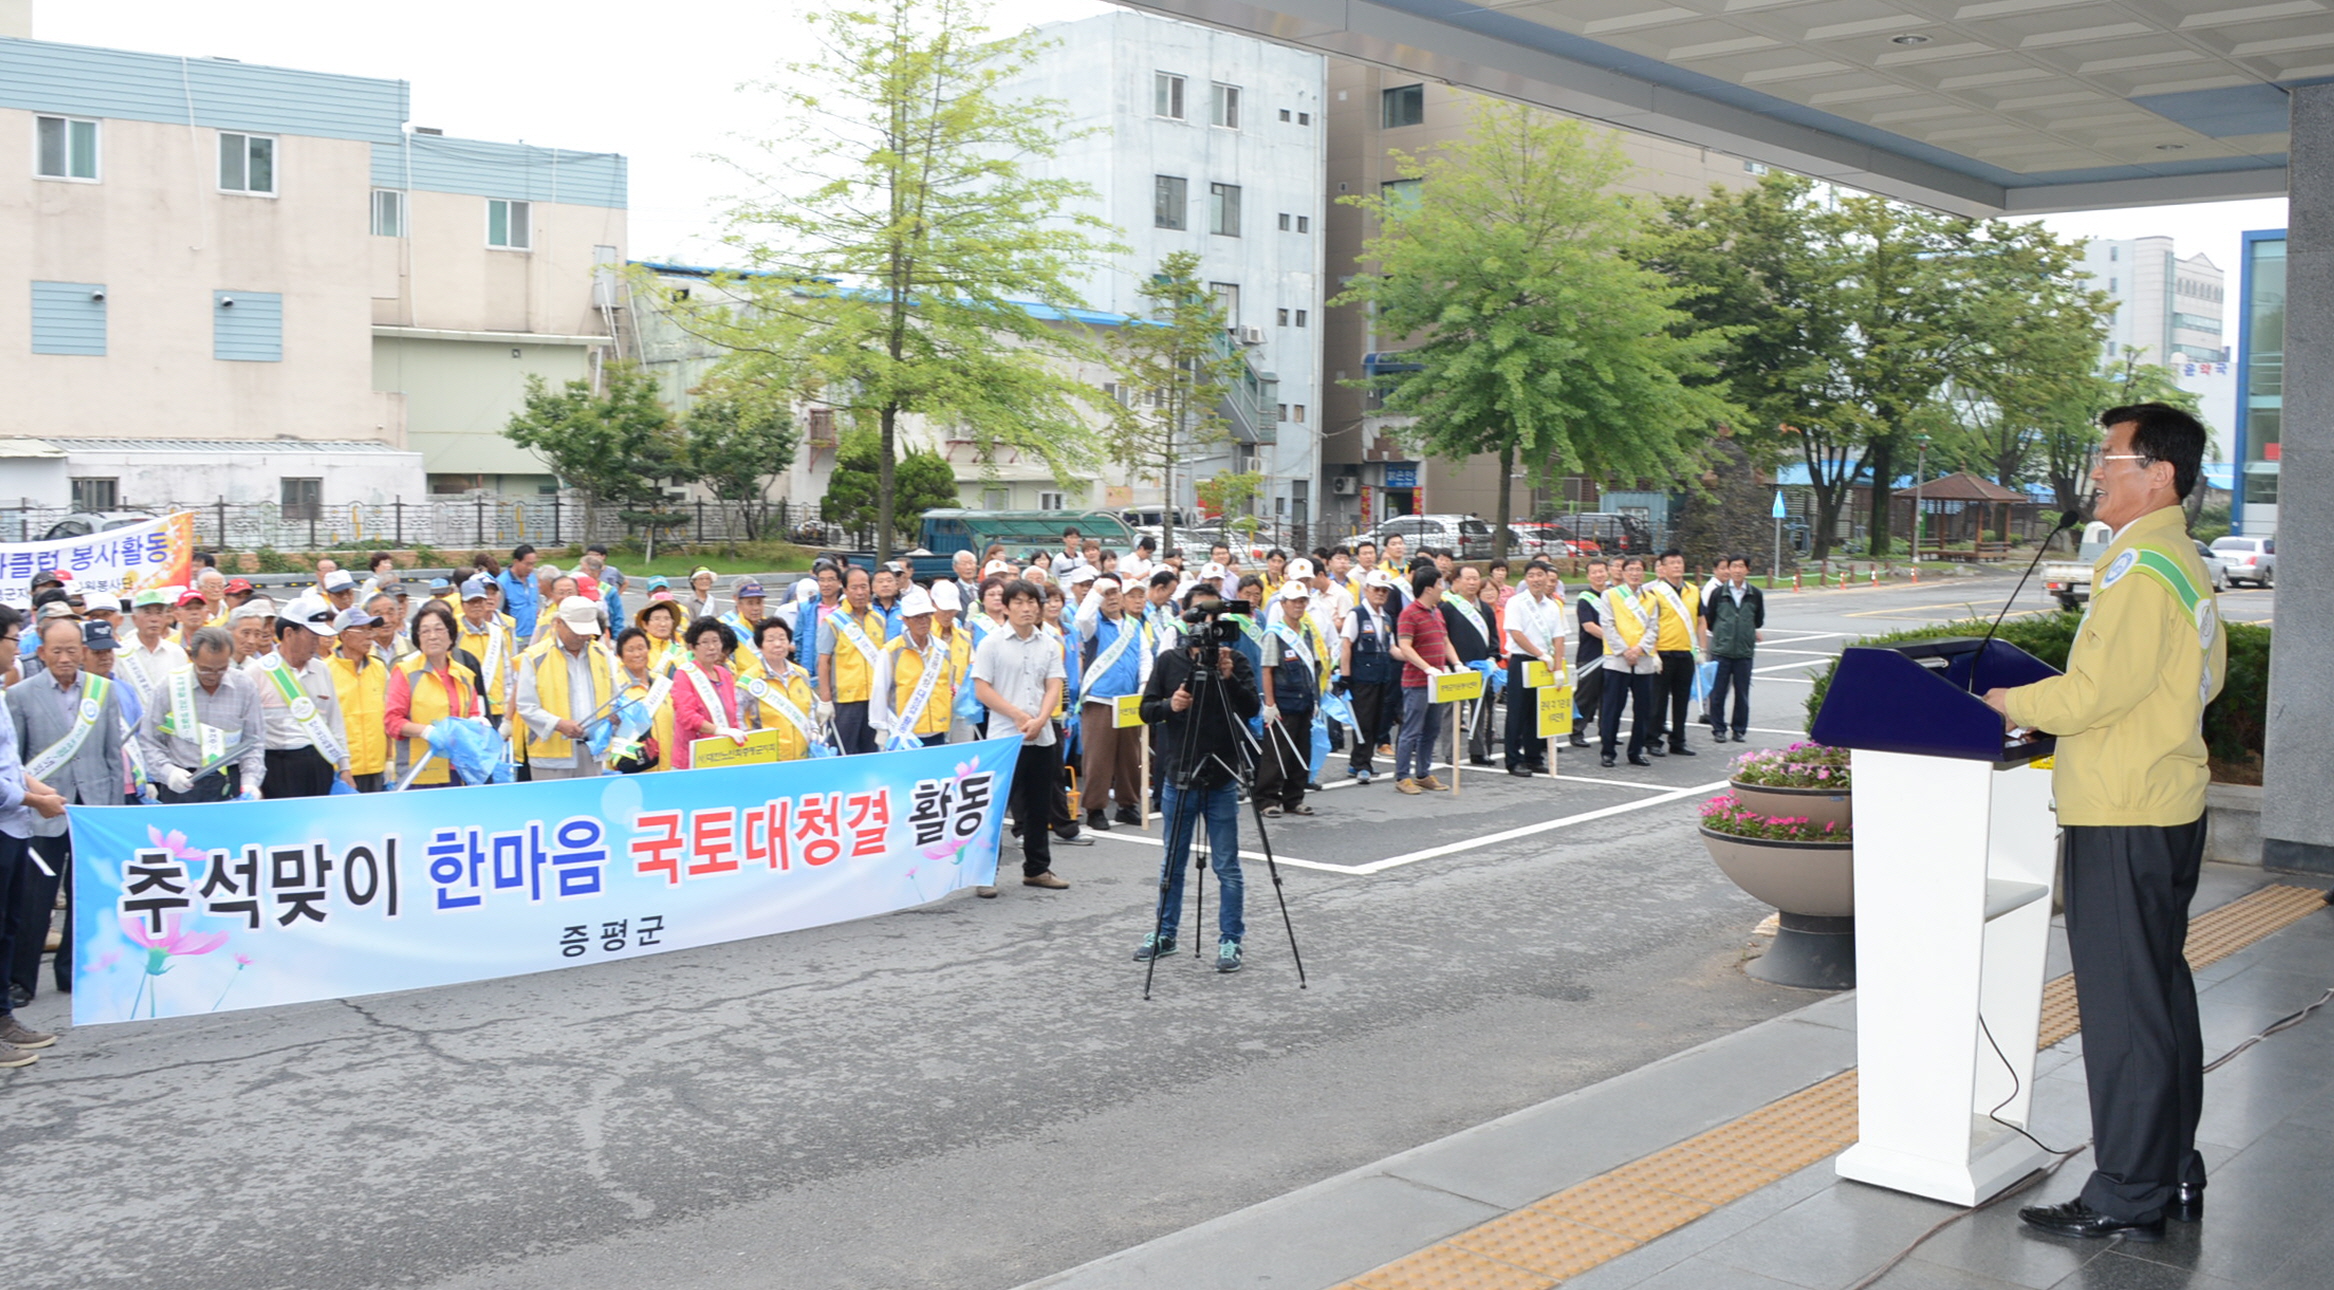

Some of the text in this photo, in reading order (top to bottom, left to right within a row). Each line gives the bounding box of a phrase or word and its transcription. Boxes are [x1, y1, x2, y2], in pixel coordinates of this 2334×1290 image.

[70, 532, 169, 571] 봉사활동
[124, 771, 995, 934] 추석맞이 한마음 국토대청결 활동
[560, 914, 665, 958] 증평군
